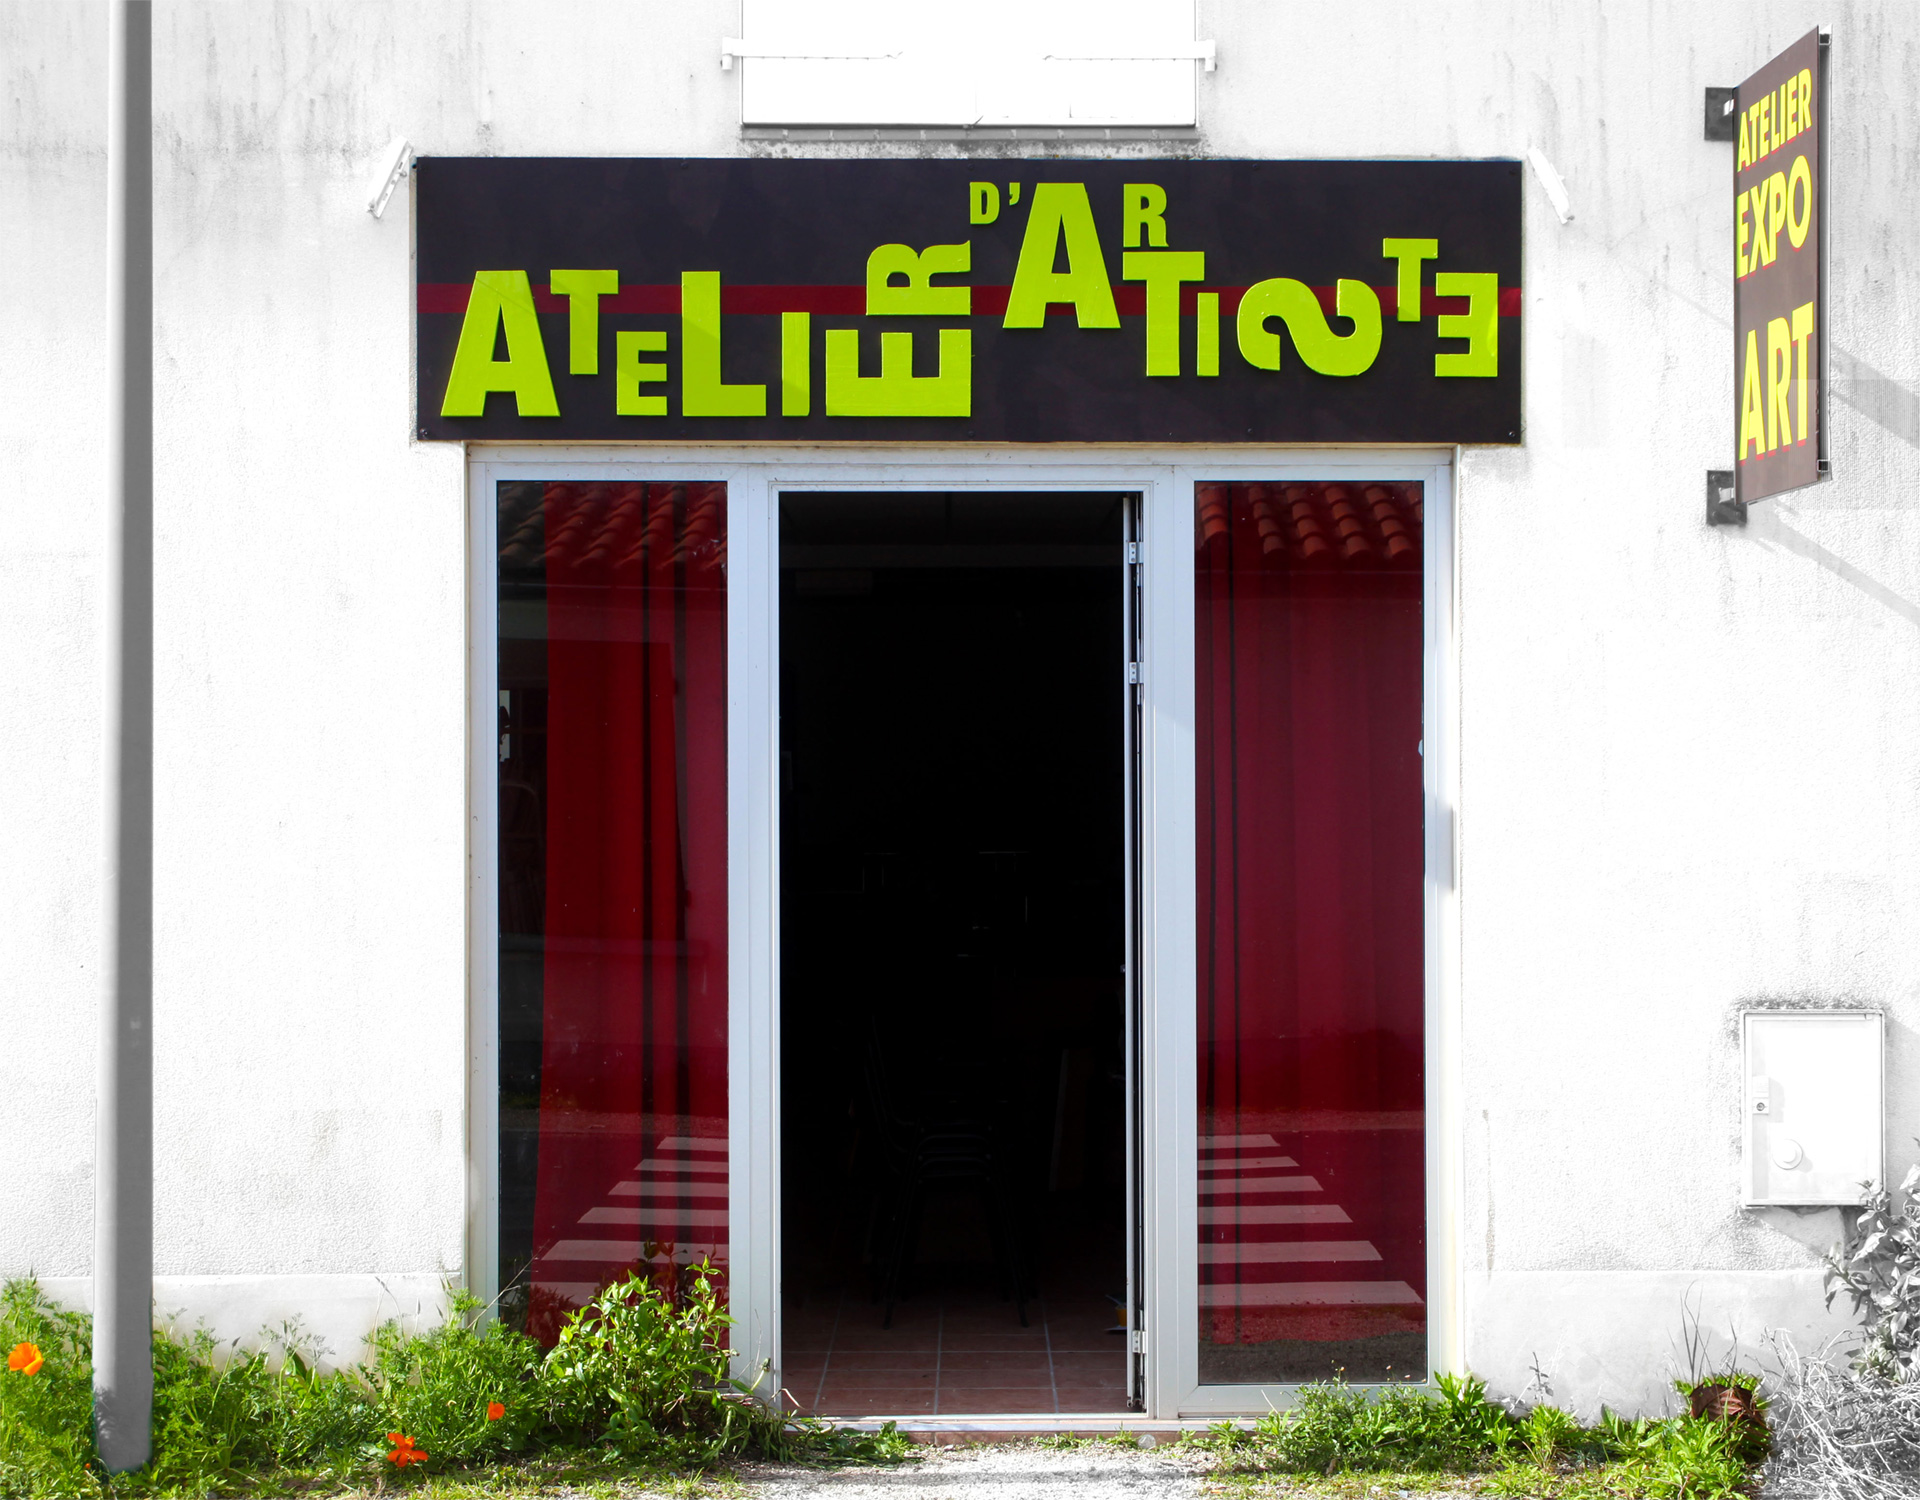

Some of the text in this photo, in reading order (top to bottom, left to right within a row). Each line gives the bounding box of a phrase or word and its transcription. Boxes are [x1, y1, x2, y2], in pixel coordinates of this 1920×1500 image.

[1737, 68, 1813, 172] ATELIER
[1736, 155, 1813, 279] EXPO
[441, 182, 1499, 417] ATELIER D'ARTISTE
[1739, 301, 1814, 461] ART
